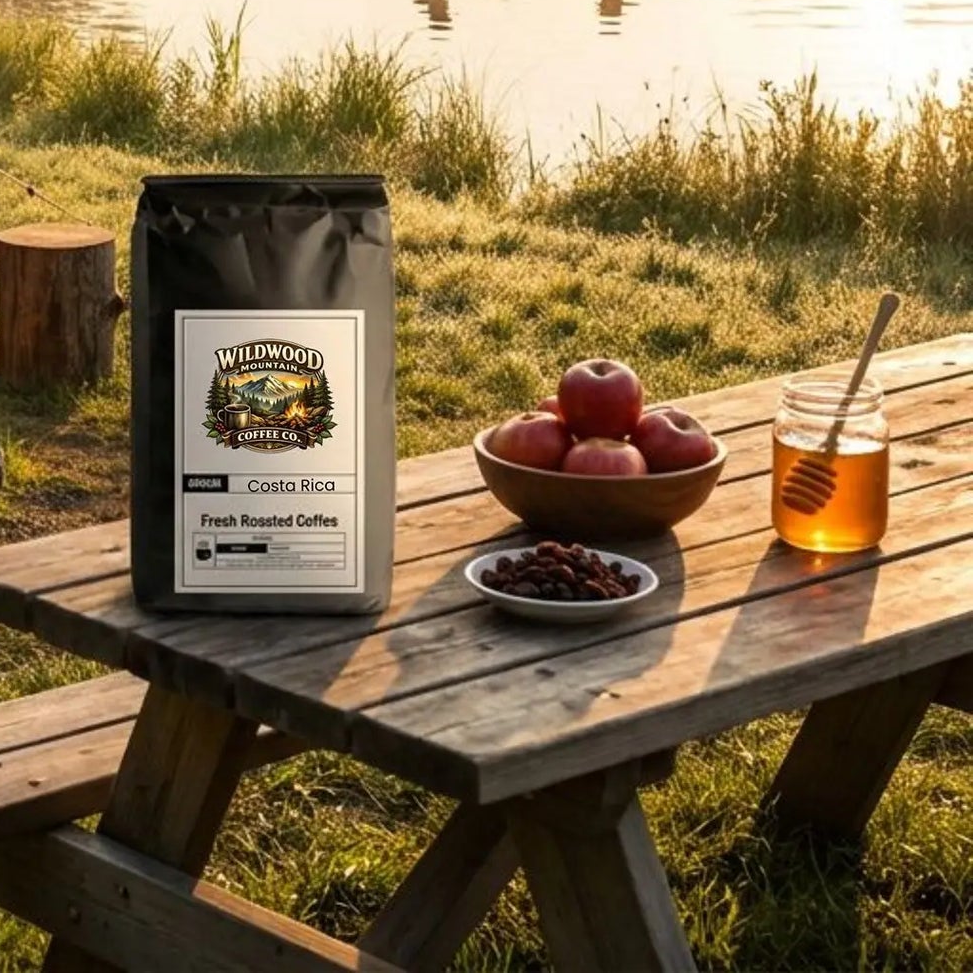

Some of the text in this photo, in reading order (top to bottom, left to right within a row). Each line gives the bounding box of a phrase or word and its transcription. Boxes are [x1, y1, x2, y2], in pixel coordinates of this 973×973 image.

[217, 344, 323, 371] WILDWOOD
[240, 362, 298, 372] MOUNTAIN
[237, 430, 301, 443] COFFEE CO.
[247, 478, 335, 493] Costa Rica
[200, 514, 237, 528] Fresh
